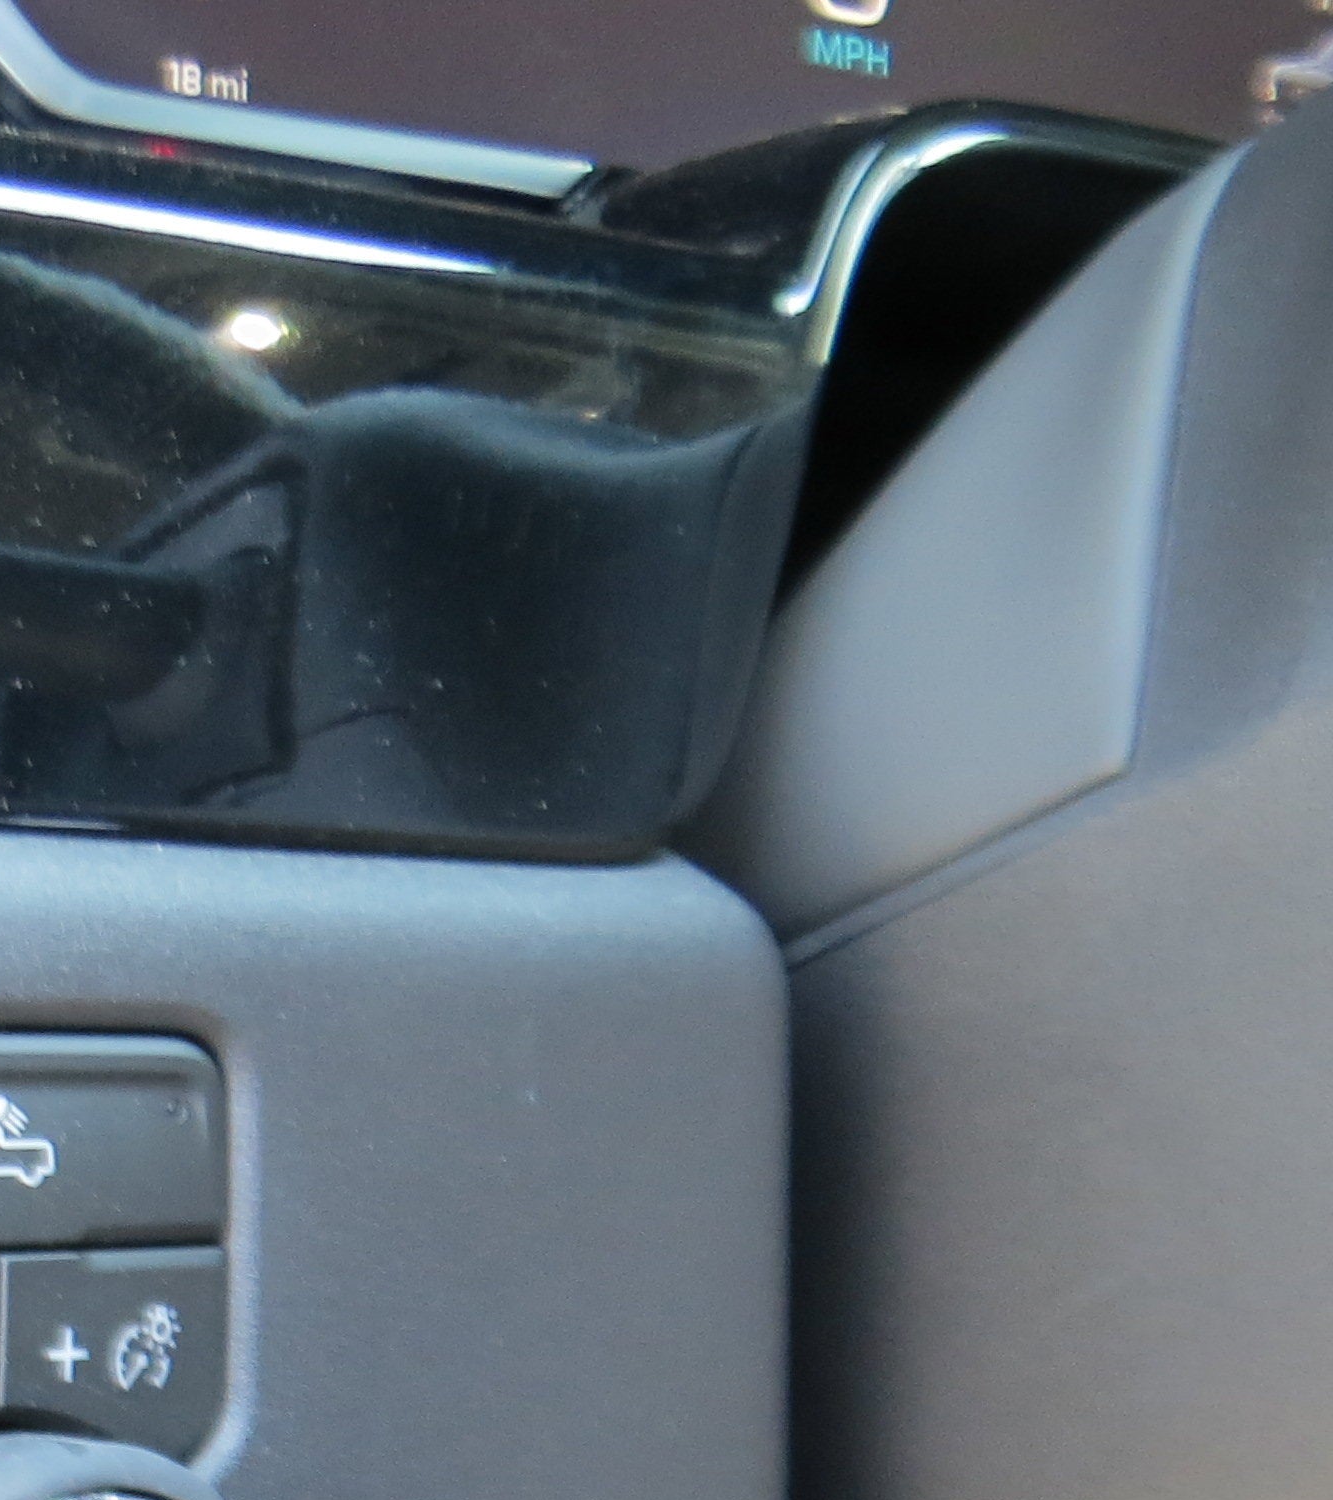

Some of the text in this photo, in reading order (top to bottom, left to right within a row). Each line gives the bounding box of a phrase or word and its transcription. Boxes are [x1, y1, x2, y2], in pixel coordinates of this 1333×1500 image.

[807, 28, 891, 78] MPH
[159, 57, 249, 103] 18 mi
